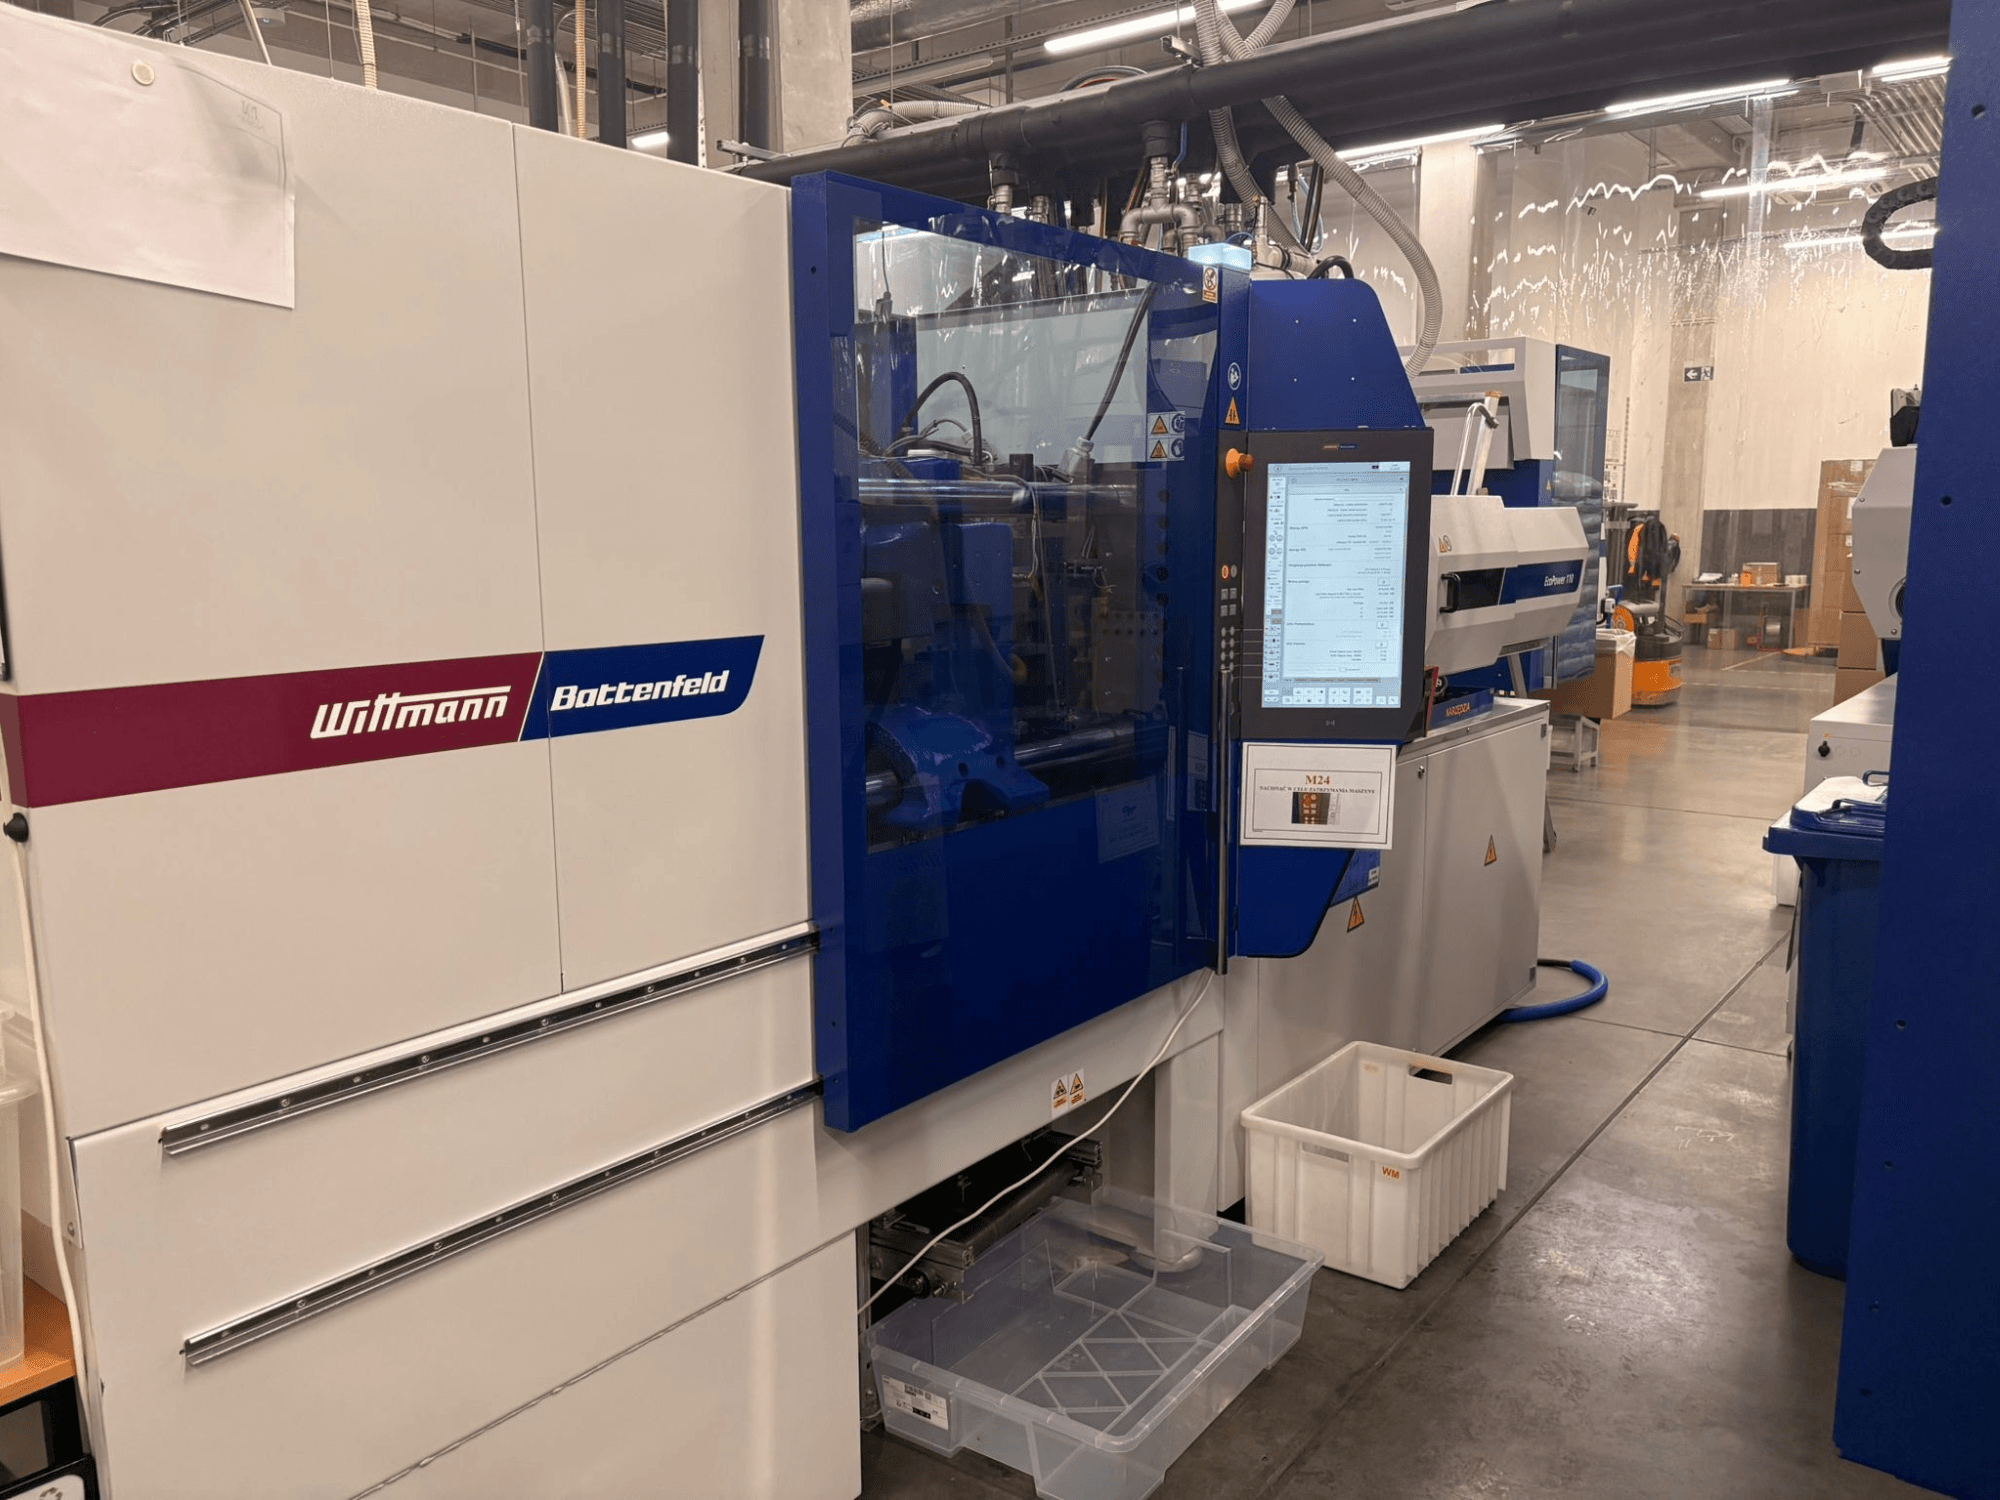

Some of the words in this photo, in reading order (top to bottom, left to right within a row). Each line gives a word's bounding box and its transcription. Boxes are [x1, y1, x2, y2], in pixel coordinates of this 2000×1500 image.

[1544, 574, 1566, 587] EcoPower
[310, 685, 512, 739] Wittmann
[550, 669, 730, 711] Battenfeld
[1305, 775, 1331, 785] M24
[1382, 1166, 1400, 1179] WM
